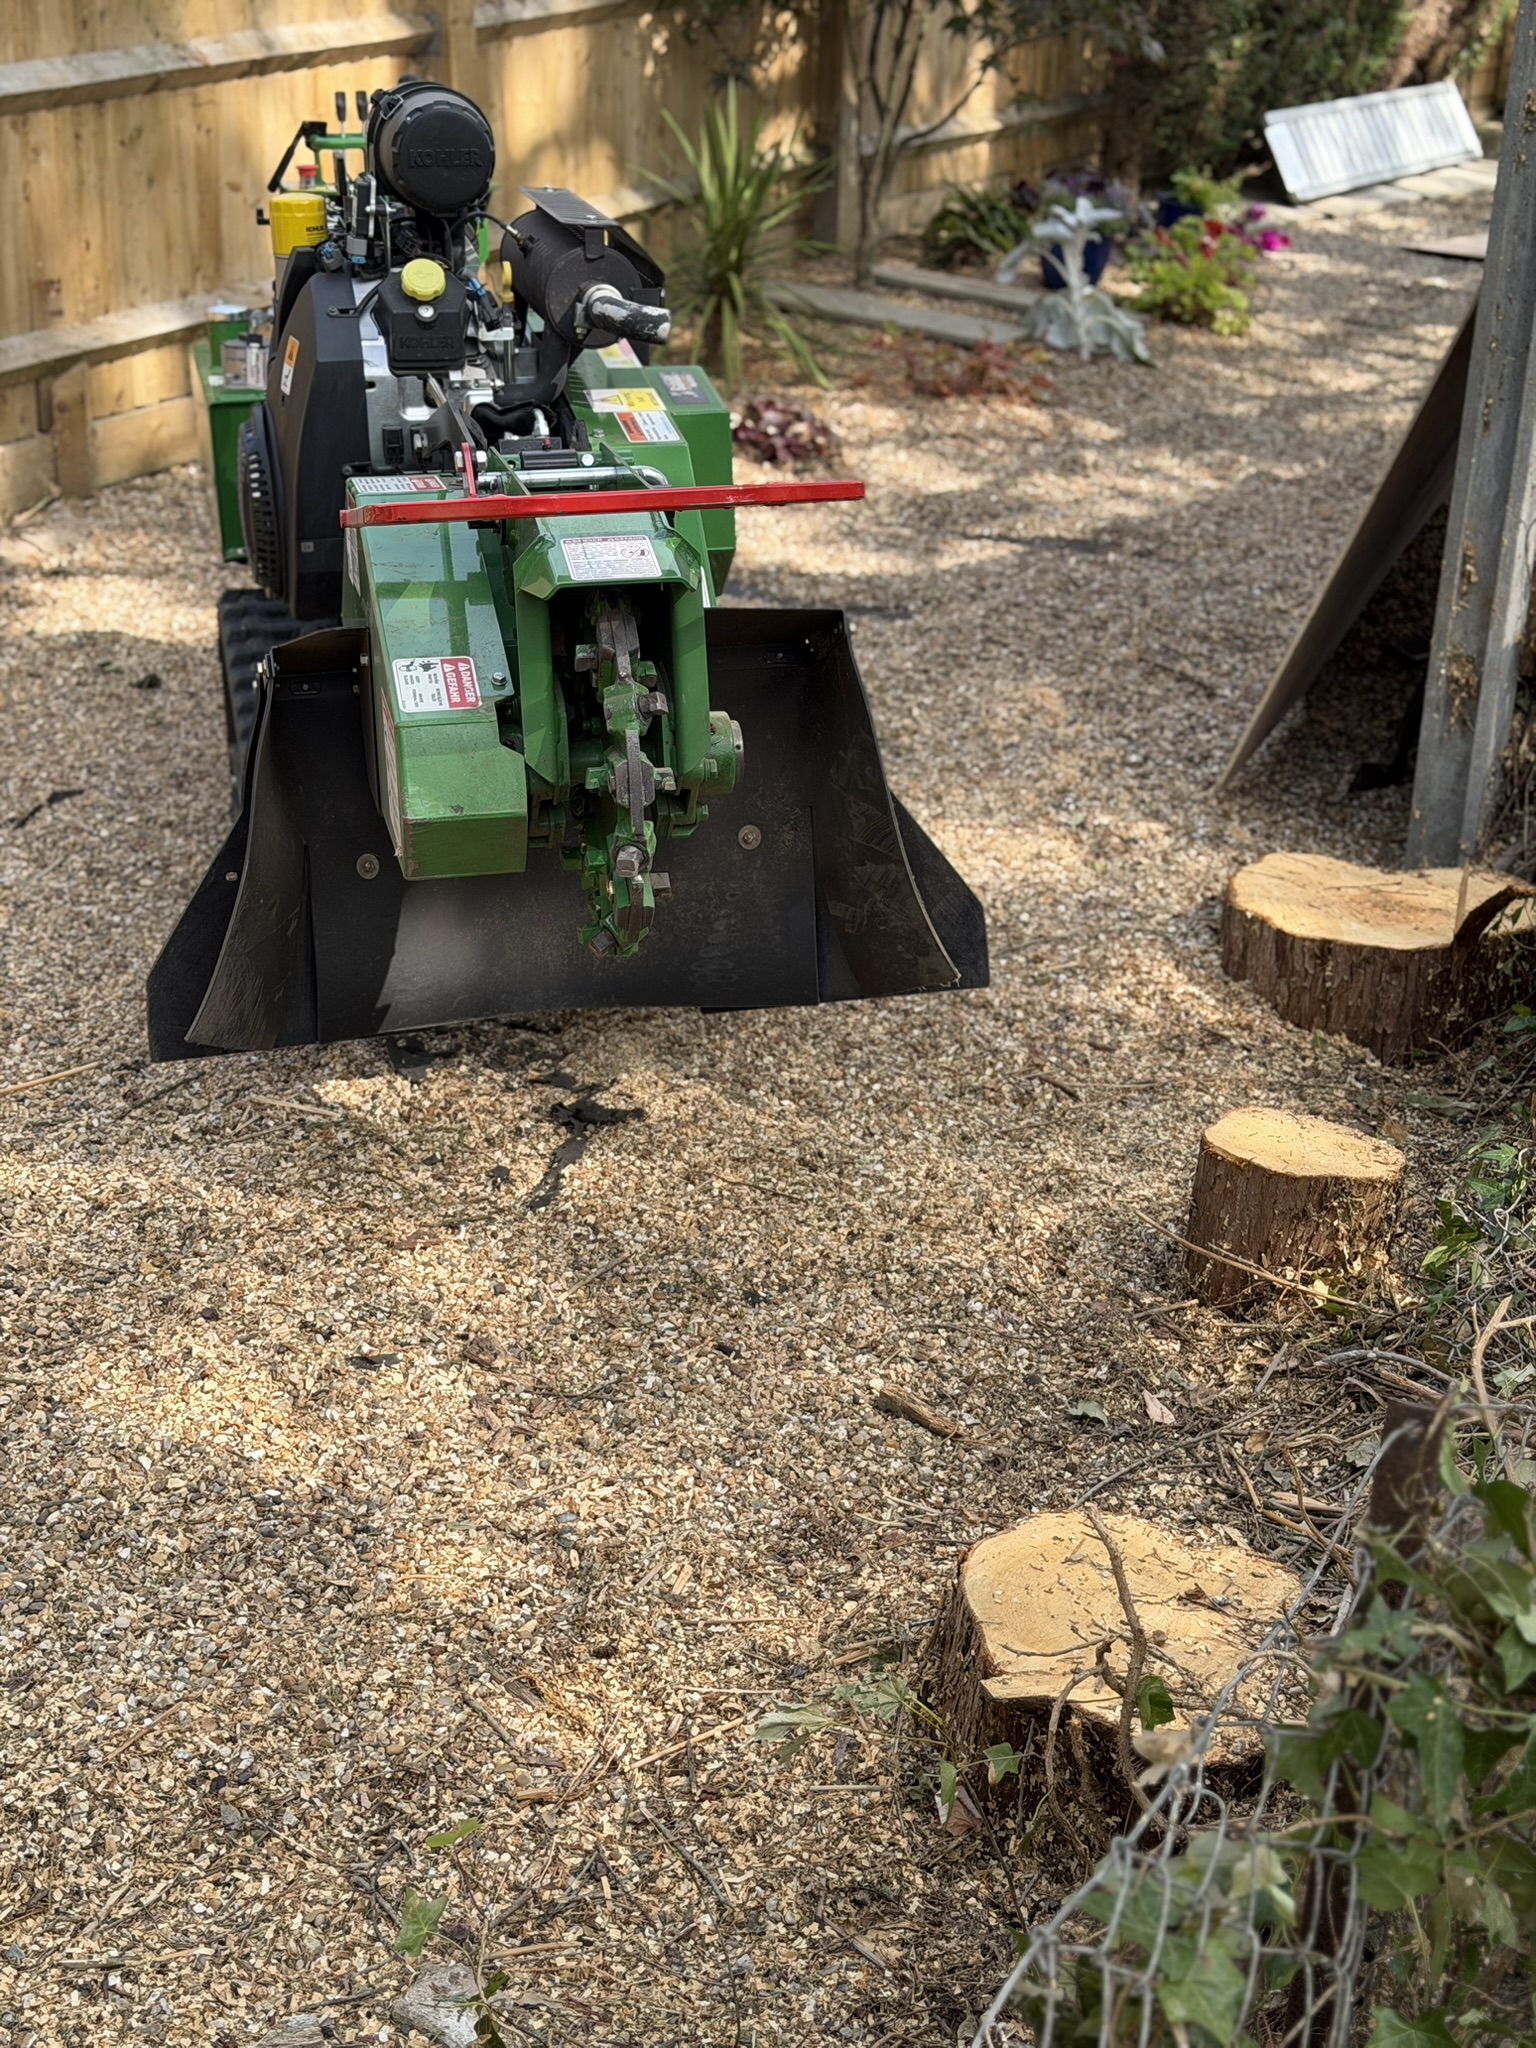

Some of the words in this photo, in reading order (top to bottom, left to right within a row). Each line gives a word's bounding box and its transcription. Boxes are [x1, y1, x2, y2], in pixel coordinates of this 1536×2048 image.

[409, 148, 482, 168] KOHLER
[399, 336, 455, 349] KOHLER
[446, 672, 461, 704] GEFAHR
[461, 671, 476, 703] DANGER
